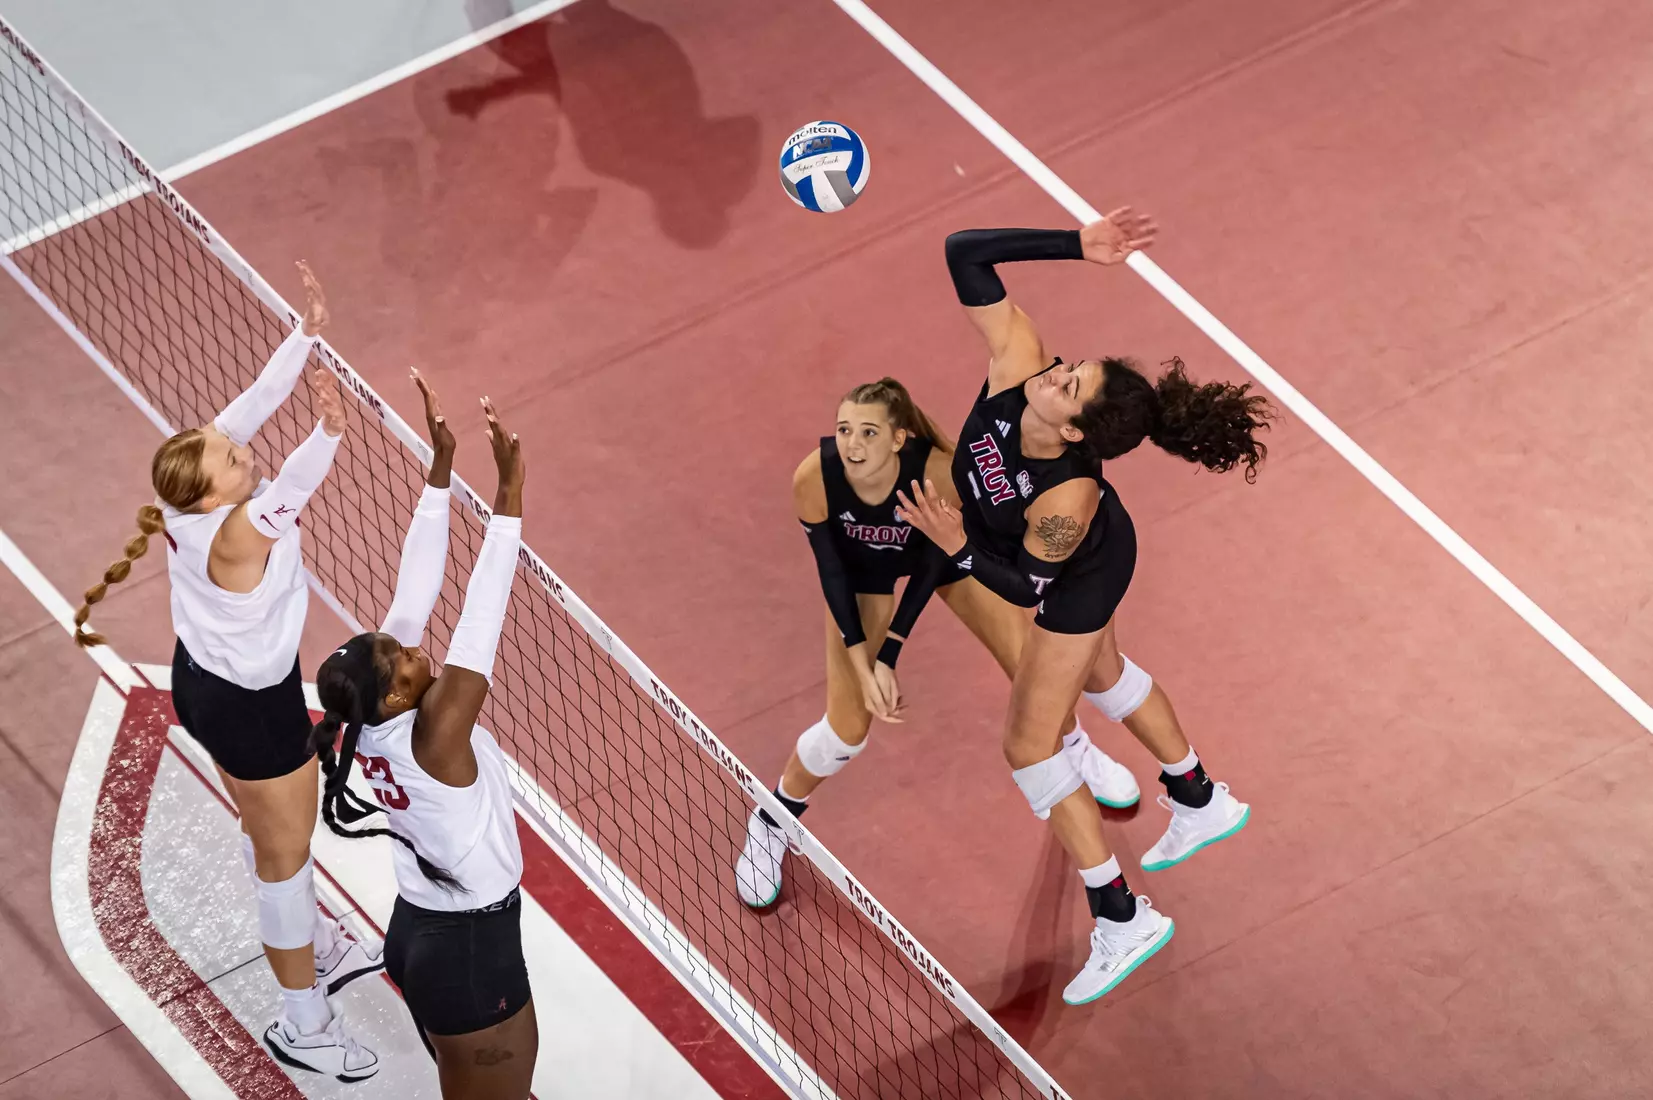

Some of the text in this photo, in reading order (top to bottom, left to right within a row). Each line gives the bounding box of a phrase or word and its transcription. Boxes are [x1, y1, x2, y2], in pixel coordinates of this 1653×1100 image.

[788, 127, 837, 146] molten
[793, 136, 831, 160] NCAA
[793, 155, 839, 174] Super Touch
[118, 140, 210, 244] TROY TROJANS
[325, 349, 385, 419] TROJANS
[969, 433, 1016, 506] TROY
[465, 490, 491, 524] TRO
[844, 522, 912, 544] TROY
[650, 678, 755, 795] TROY TROJANS
[845, 875, 956, 999] TROY TROJANS
